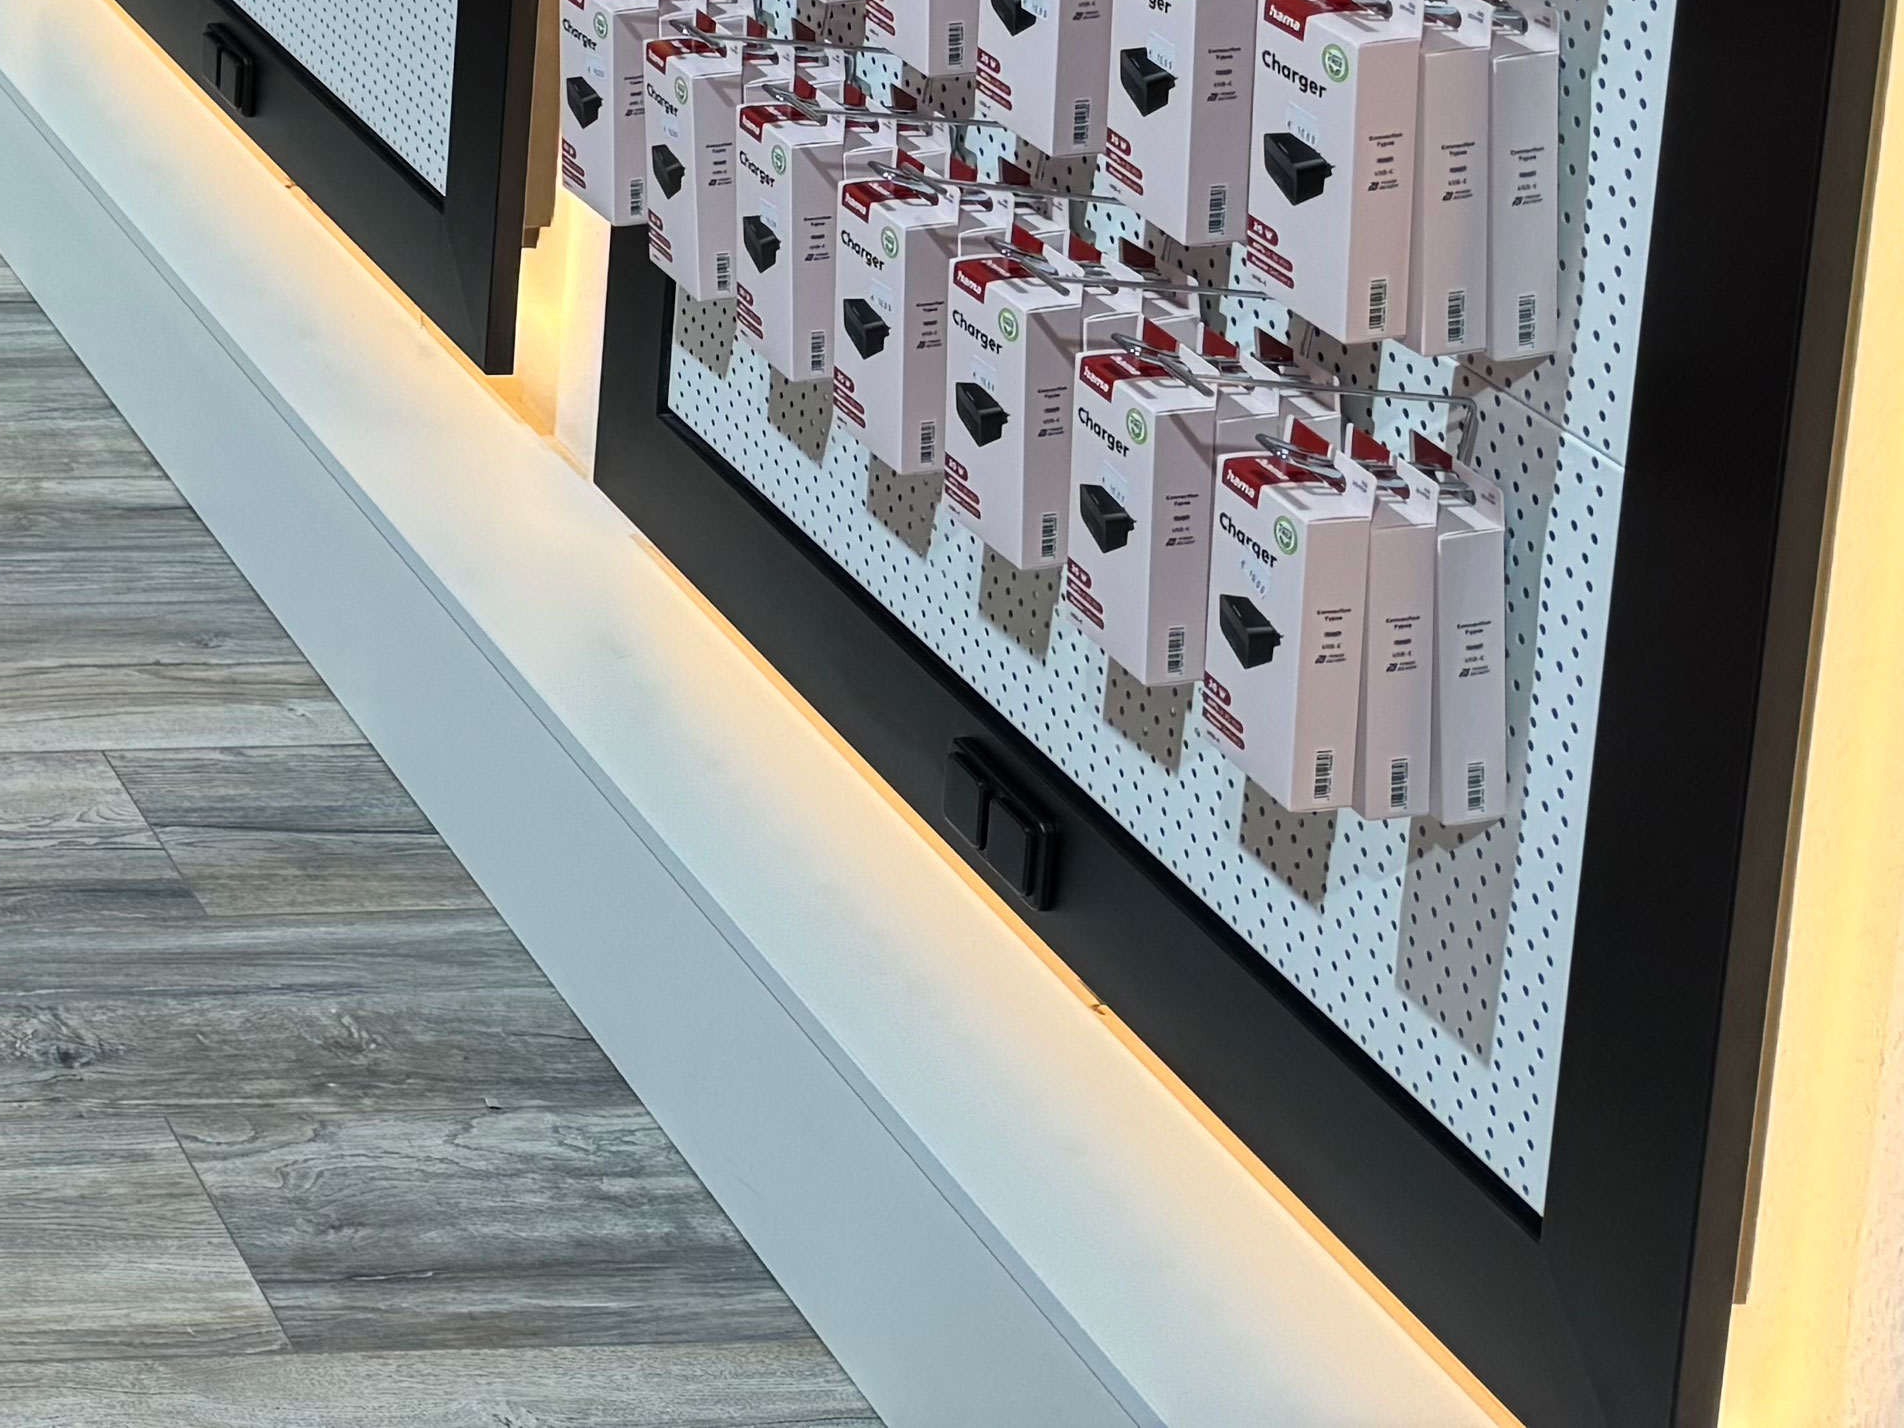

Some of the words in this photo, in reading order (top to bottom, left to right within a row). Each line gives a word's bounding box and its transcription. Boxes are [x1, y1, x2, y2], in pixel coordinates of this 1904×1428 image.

[562, 18, 597, 51] Charger
[1268, 5, 1301, 32] hama
[1261, 49, 1327, 99] Charger
[646, 82, 678, 118] Charger
[739, 150, 775, 189] Charger
[840, 229, 885, 272] Charger
[957, 268, 983, 295] hama
[952, 309, 1003, 355] Charger
[1083, 364, 1111, 394] hama
[1077, 406, 1130, 458] Charger
[1226, 468, 1256, 499] hama
[1219, 512, 1277, 569] Charger
